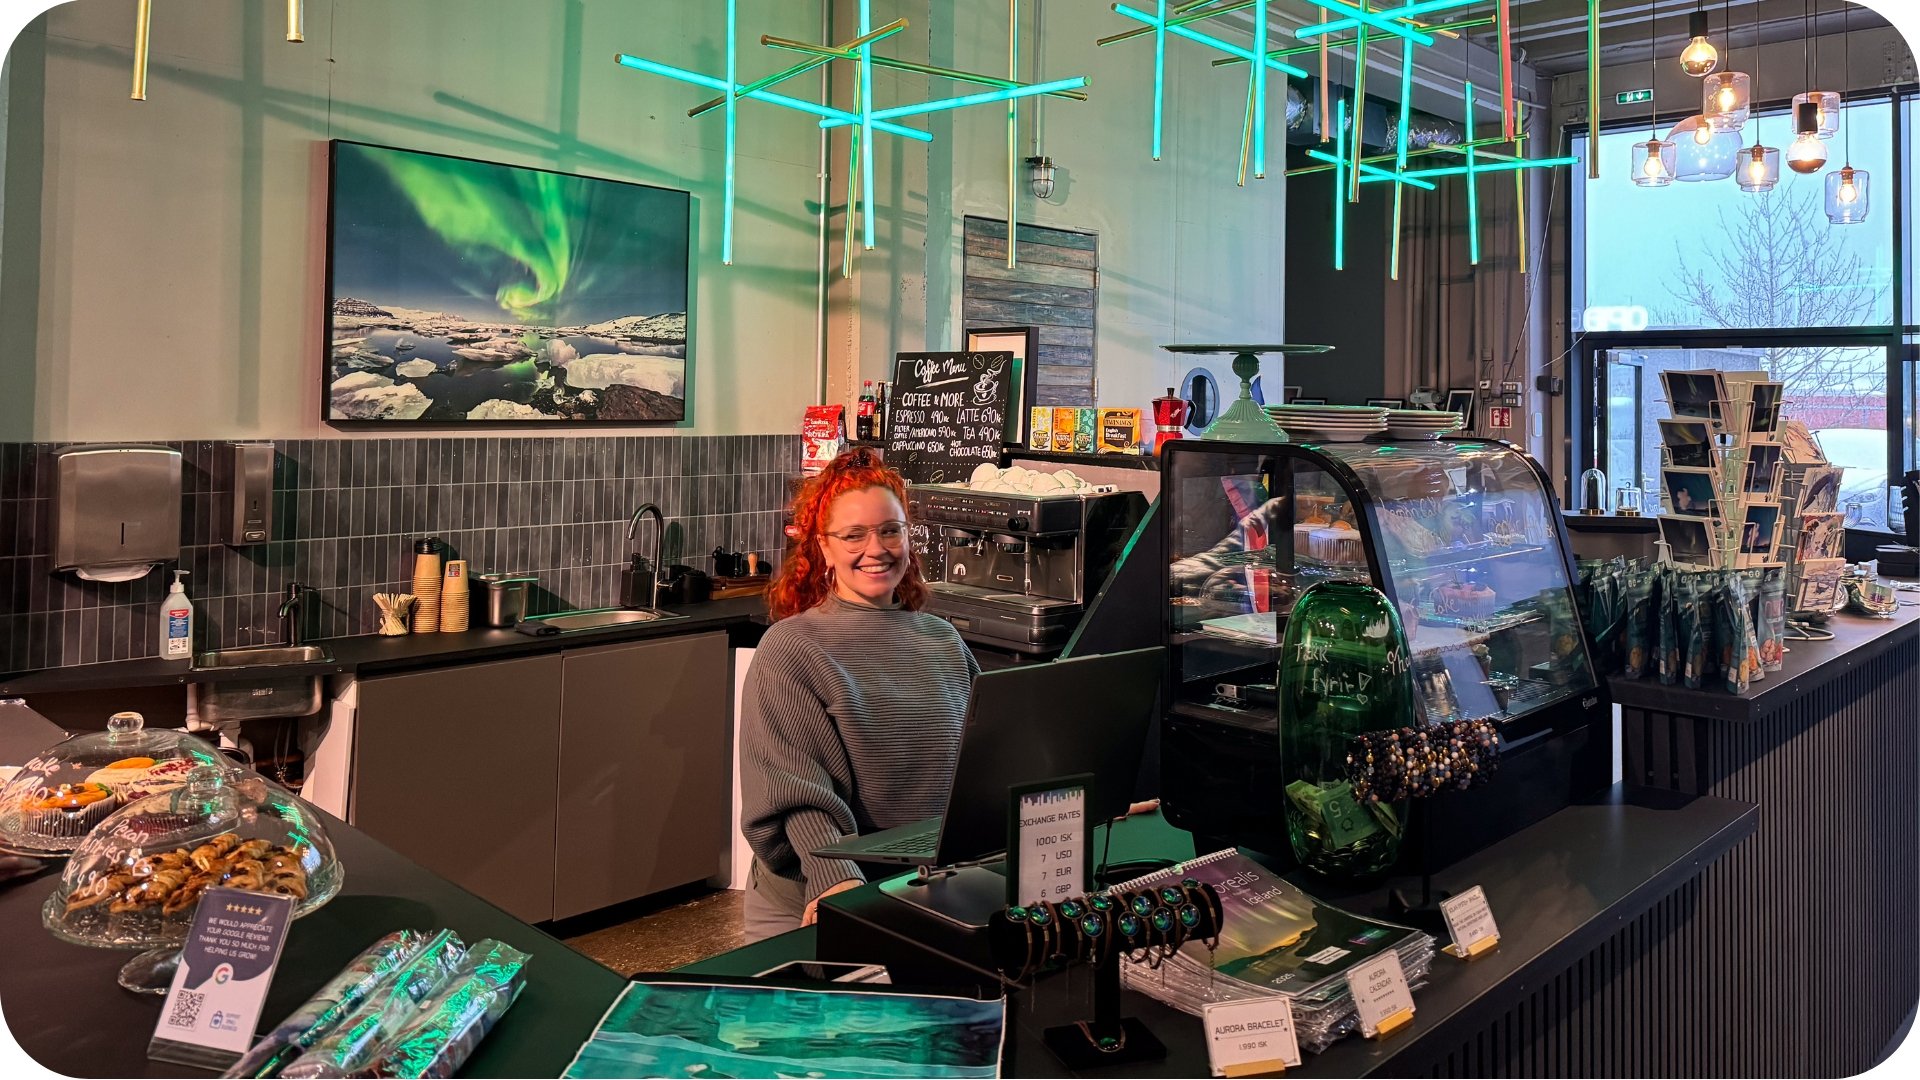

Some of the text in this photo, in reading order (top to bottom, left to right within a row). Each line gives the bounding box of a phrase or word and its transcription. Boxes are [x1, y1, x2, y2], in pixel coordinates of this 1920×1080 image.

[914, 358, 967, 383] Coffee Menu
[902, 392, 966, 407] COFFEE & MORE
[896, 410, 925, 423] ESPRESSO
[956, 408, 980, 424] LATTE
[894, 425, 910, 433] FILTER
[963, 426, 976, 440] TEA
[892, 440, 925, 451] CAPPUCCINO
[949, 446, 981, 457] CHOCOLATE
[1019, 810, 1081, 828] EXCHANGE RATES
[1036, 833, 1072, 847] 1000 ISK
[1041, 850, 1072, 863] 7 USD
[1042, 867, 1072, 881] 7 EUR
[1212, 871, 1260, 895] orealis
[1041, 884, 1072, 898] 6 GBP
[1242, 885, 1283, 906] Iceland
[208, 917, 273, 933] WE WOULD APPRECIATE
[206, 926, 222, 935] YOUR
[222, 929, 245, 939] GOOGLE
[199, 935, 218, 944] THANK
[219, 938, 231, 946] YOU
[240, 941, 257, 950] MUCH
[258, 944, 270, 952] FOR
[204, 946, 228, 956] HELPING
[1215, 1018, 1284, 1035] AURORA BRACELET
[1258, 1040, 1268, 1048] ISK
